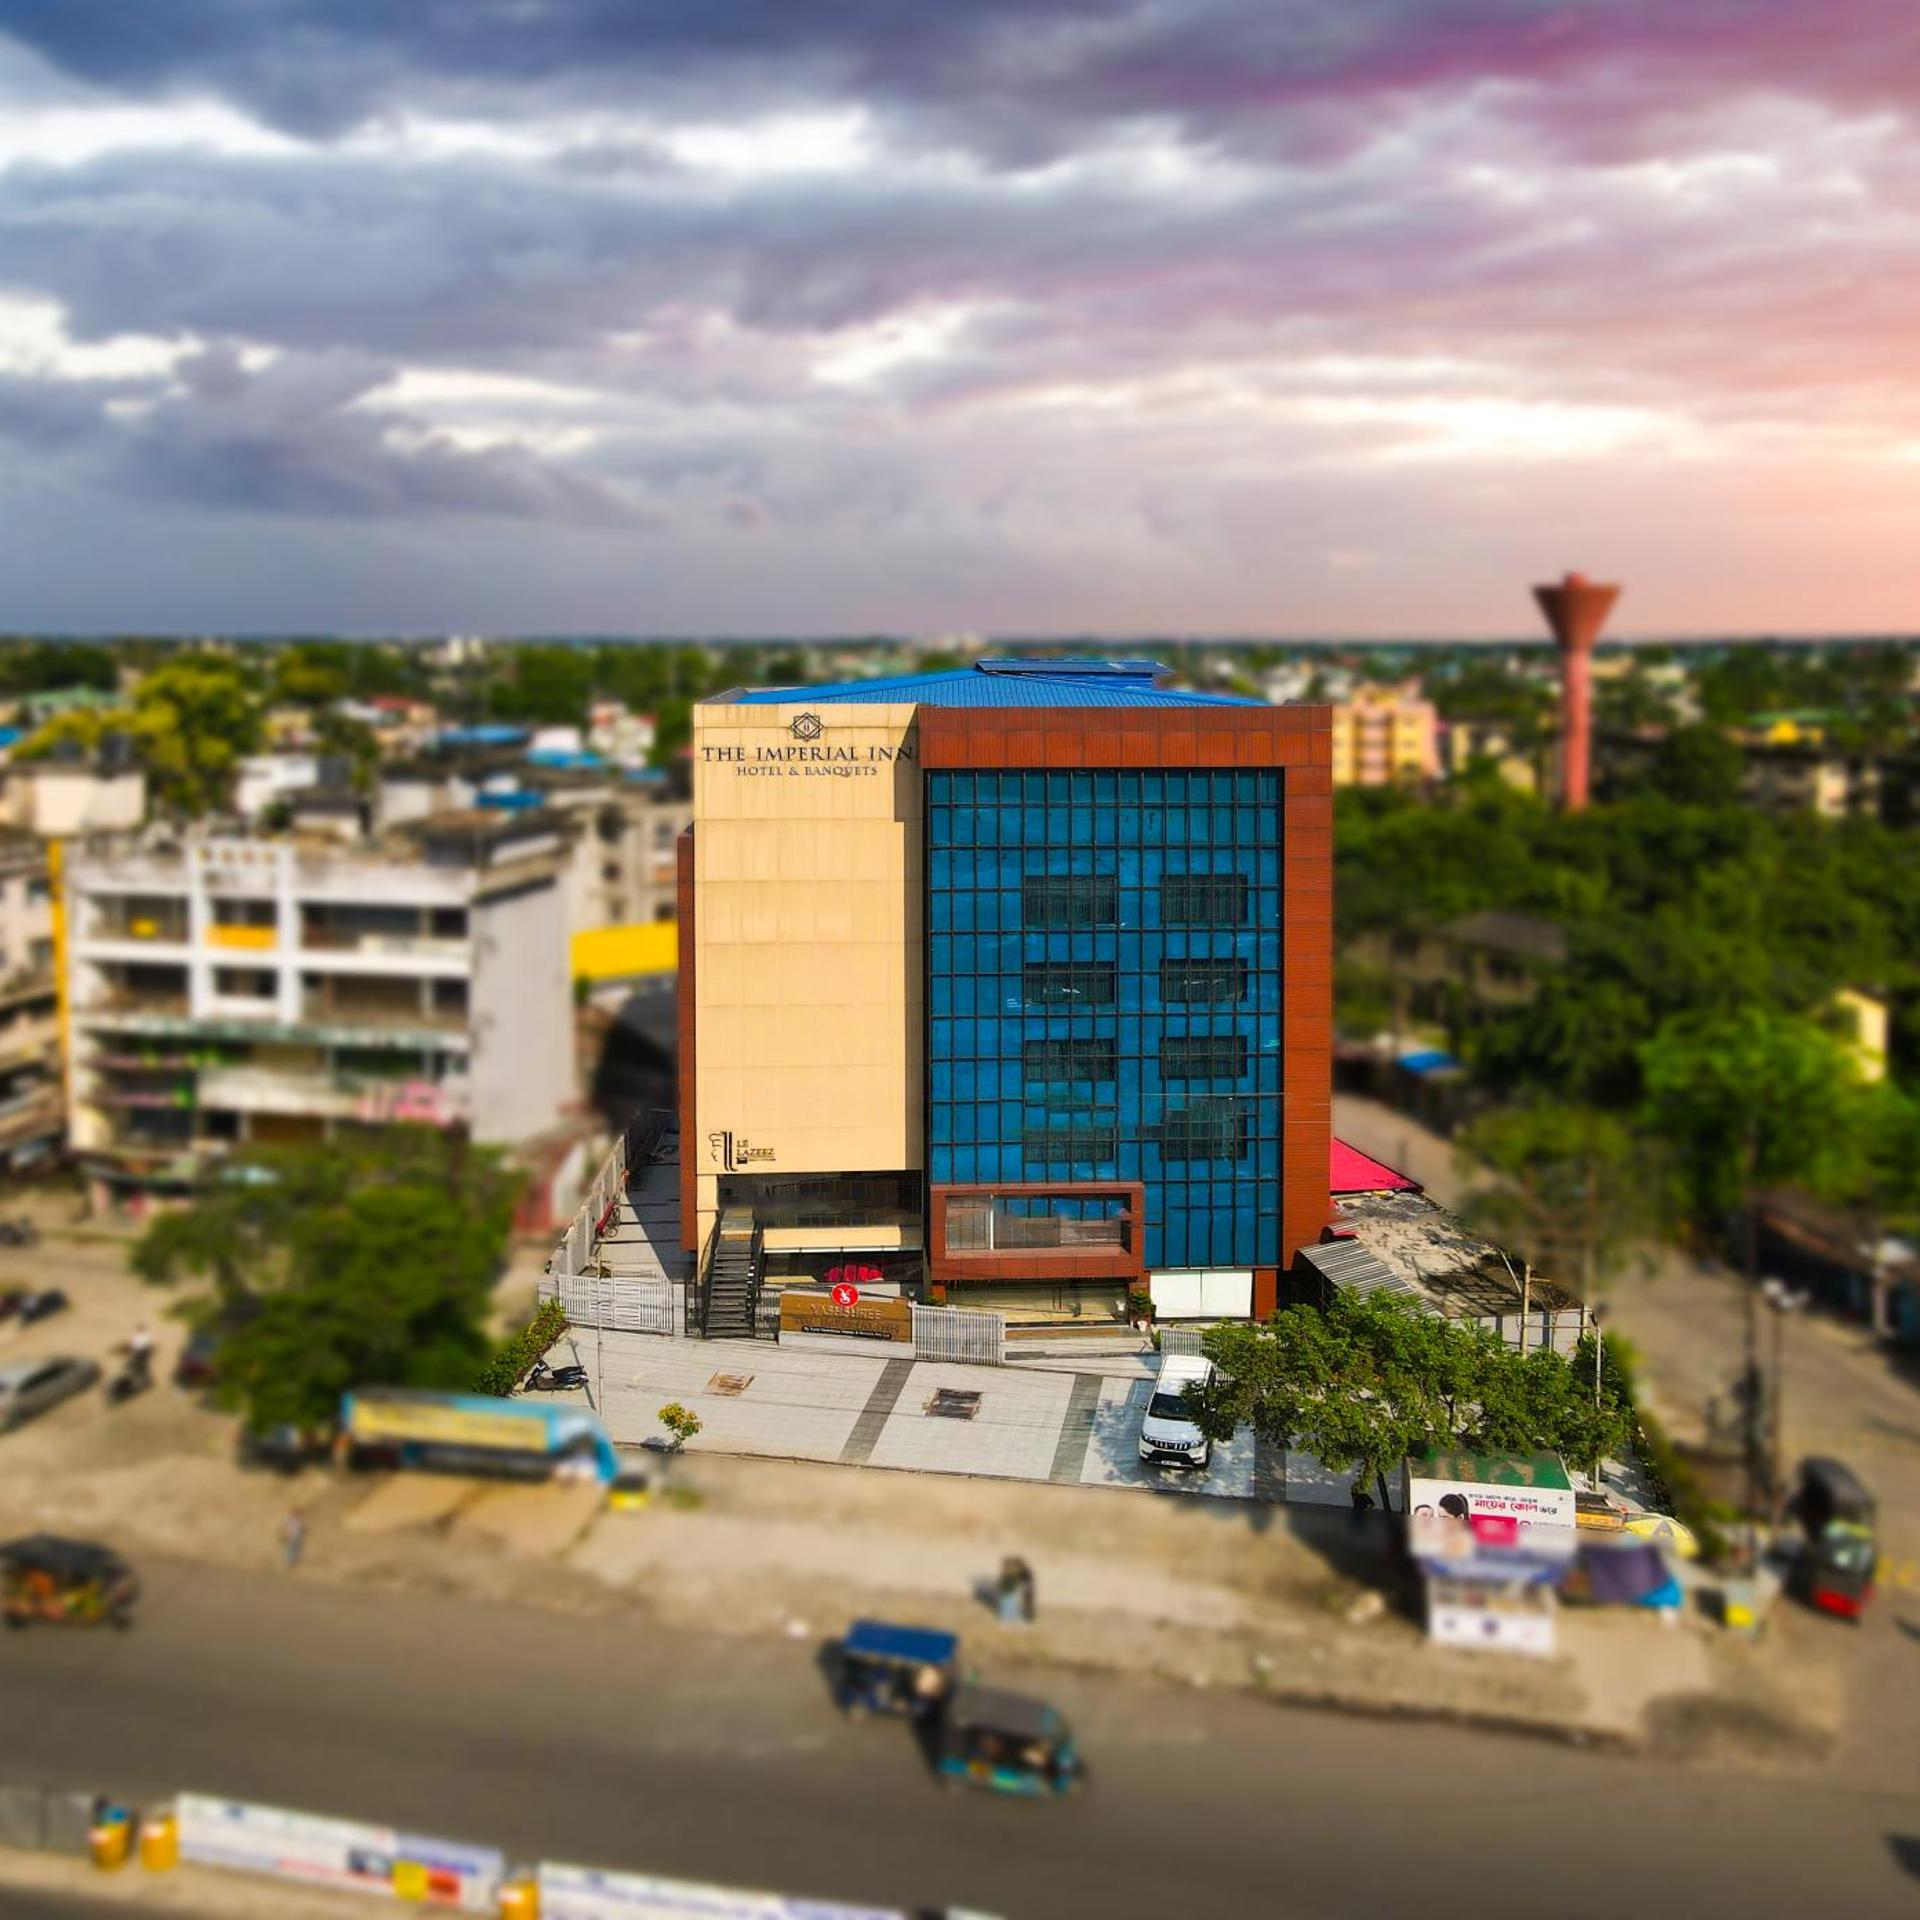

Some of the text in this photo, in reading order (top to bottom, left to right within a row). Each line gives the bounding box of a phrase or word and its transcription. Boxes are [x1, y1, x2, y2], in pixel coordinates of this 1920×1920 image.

[702, 746, 914, 762] THE IMPERIAL INN
[736, 766, 878, 778] HOTEL & BANQUETS
[736, 1148, 775, 1157] LAZEEZ
